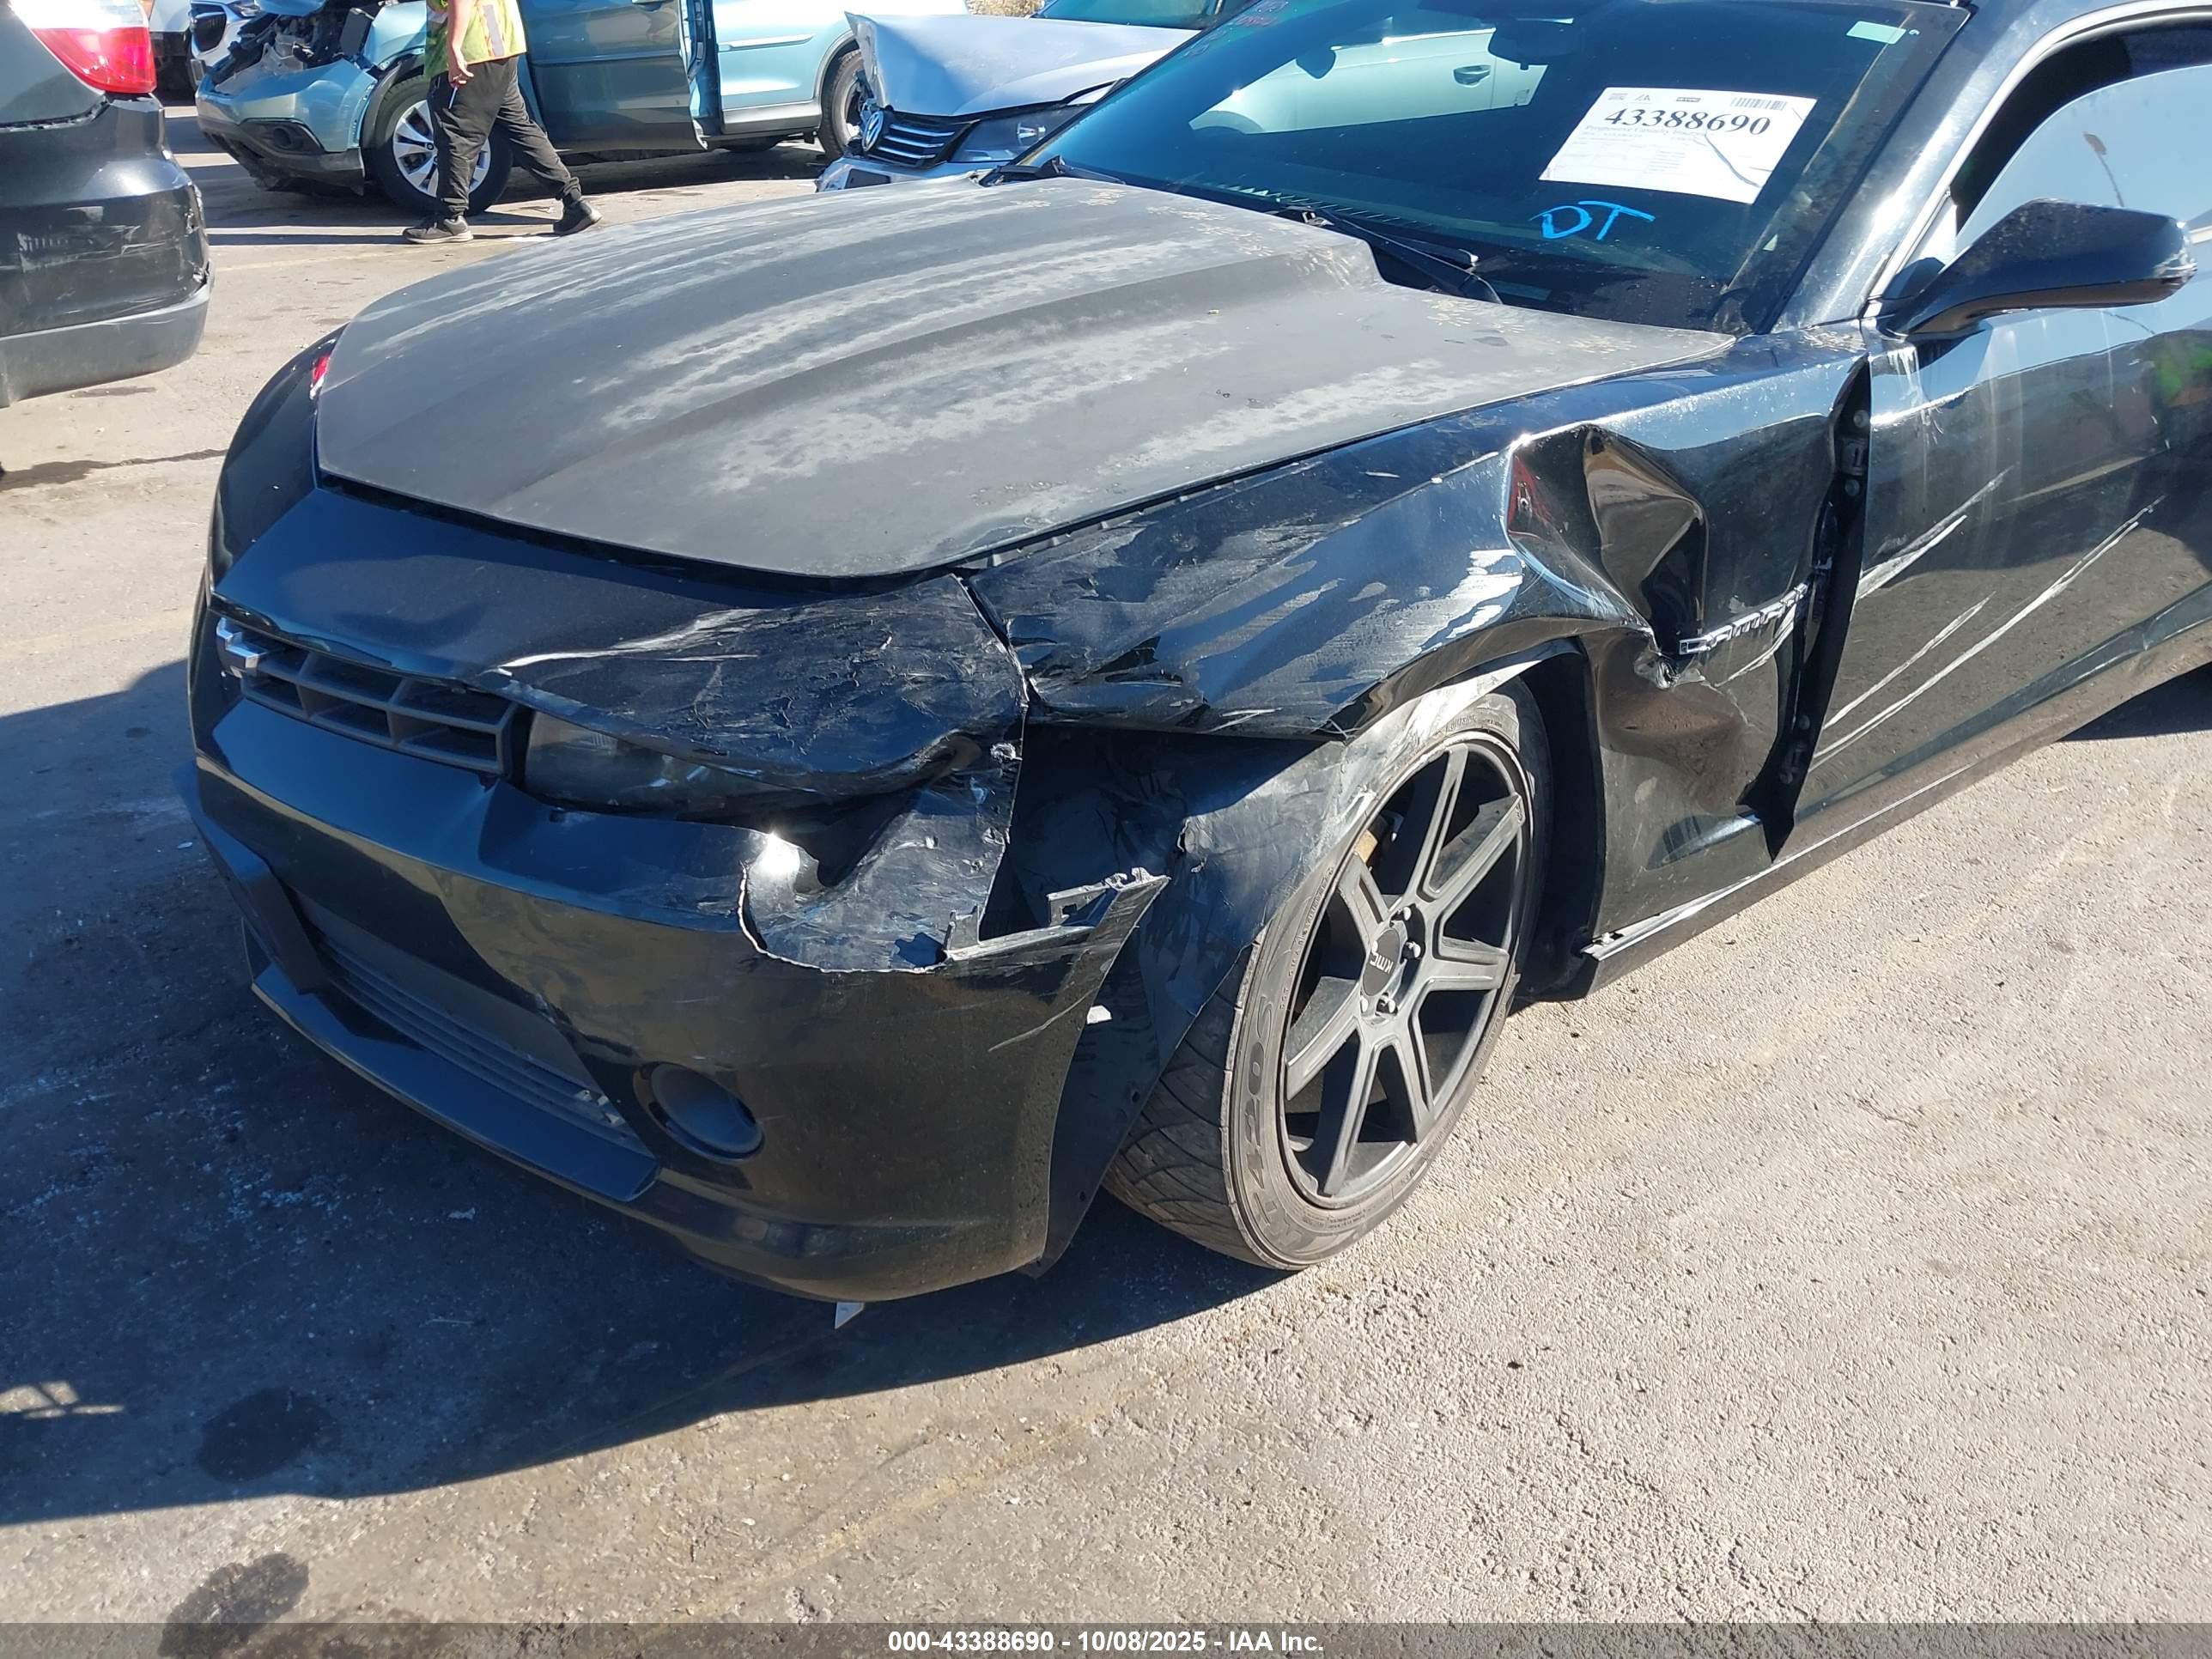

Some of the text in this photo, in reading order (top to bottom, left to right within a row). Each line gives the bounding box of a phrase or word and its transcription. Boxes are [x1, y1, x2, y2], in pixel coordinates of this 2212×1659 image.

[1603, 108, 1771, 136] 43388690
[1528, 200, 1656, 240] DT
[1370, 952, 1395, 975] KMC
